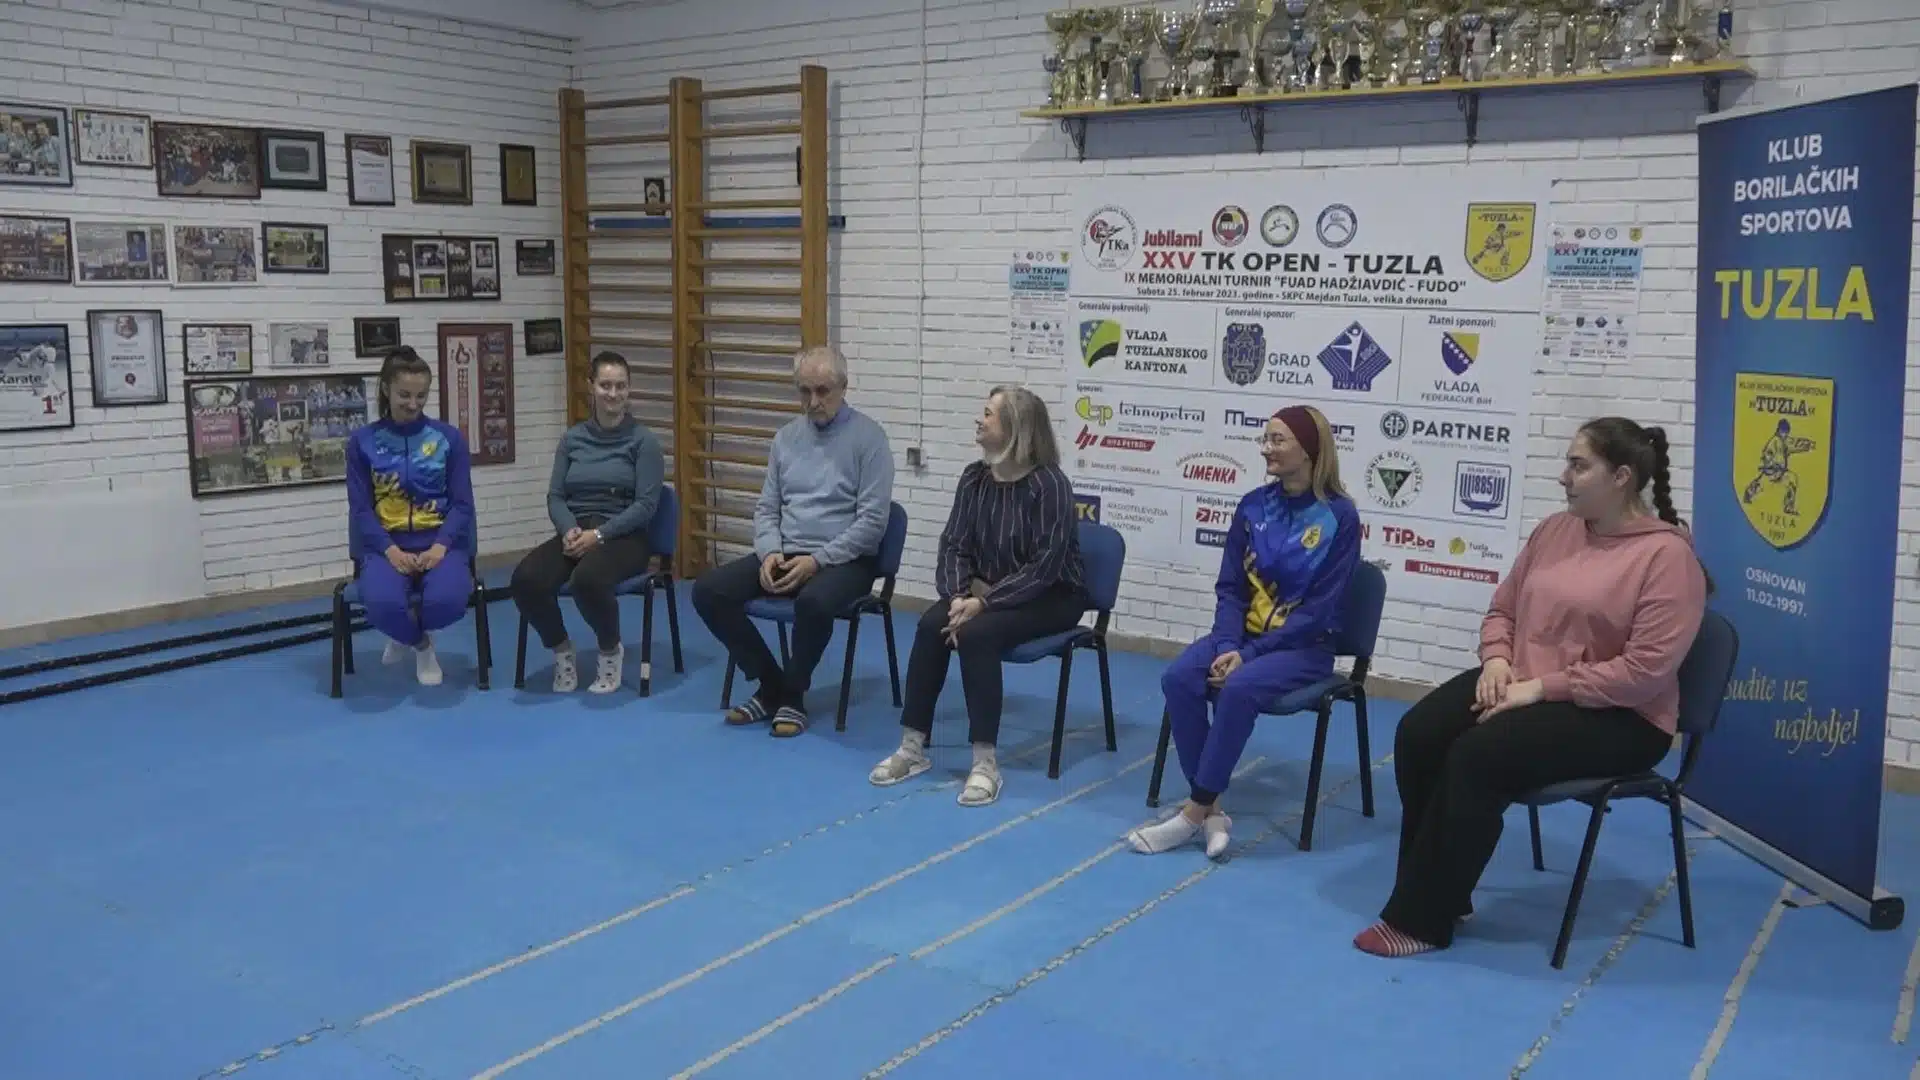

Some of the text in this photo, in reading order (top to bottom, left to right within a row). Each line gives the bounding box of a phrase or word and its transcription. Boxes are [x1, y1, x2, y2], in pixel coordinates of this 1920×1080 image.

[1768, 134, 1823, 163] KLUB
[1733, 165, 1860, 202] BORILAČKIH
[1740, 205, 1853, 236] SPORTOVA
[1142, 251, 1196, 269] XXV
[1201, 252, 1235, 271] TK
[1242, 253, 1320, 273] OPEN
[1344, 254, 1444, 275] TUZLA
[1602, 248, 1638, 257] OPEN
[1124, 272, 1136, 284] IX
[1138, 272, 1224, 286] MEMORIJALNI
[1224, 275, 1271, 287] TURNIR
[1320, 275, 1407, 292] HADŽIAVDIĆ
[1137, 287, 1165, 297] Subota
[1167, 288, 1181, 297] 25.
[1182, 288, 1214, 299] februar
[1243, 291, 1273, 301] godine
[1306, 293, 1341, 304] Mejdan
[1373, 294, 1403, 305] velika
[1405, 295, 1448, 306] dvorana
[1714, 266, 1875, 321] TUZLA
[1428, 314, 1454, 326] Zlatni
[1126, 329, 1167, 342] VLADA
[1125, 345, 1208, 360] TUZLANSKOG
[1268, 352, 1310, 368] GRAD
[1125, 361, 1187, 375] KANTONA
[1267, 370, 1314, 386] TUZLA
[1434, 380, 1480, 394] VLADA
[1412, 420, 1510, 443] PARTNER
[1183, 463, 1236, 484] LIMENKA
[1746, 567, 1806, 595] OSNOVAN
[1746, 588, 1807, 617] 11.02.1997.
[1783, 680, 1808, 702] uz
[1774, 706, 1860, 756] najbolje!
